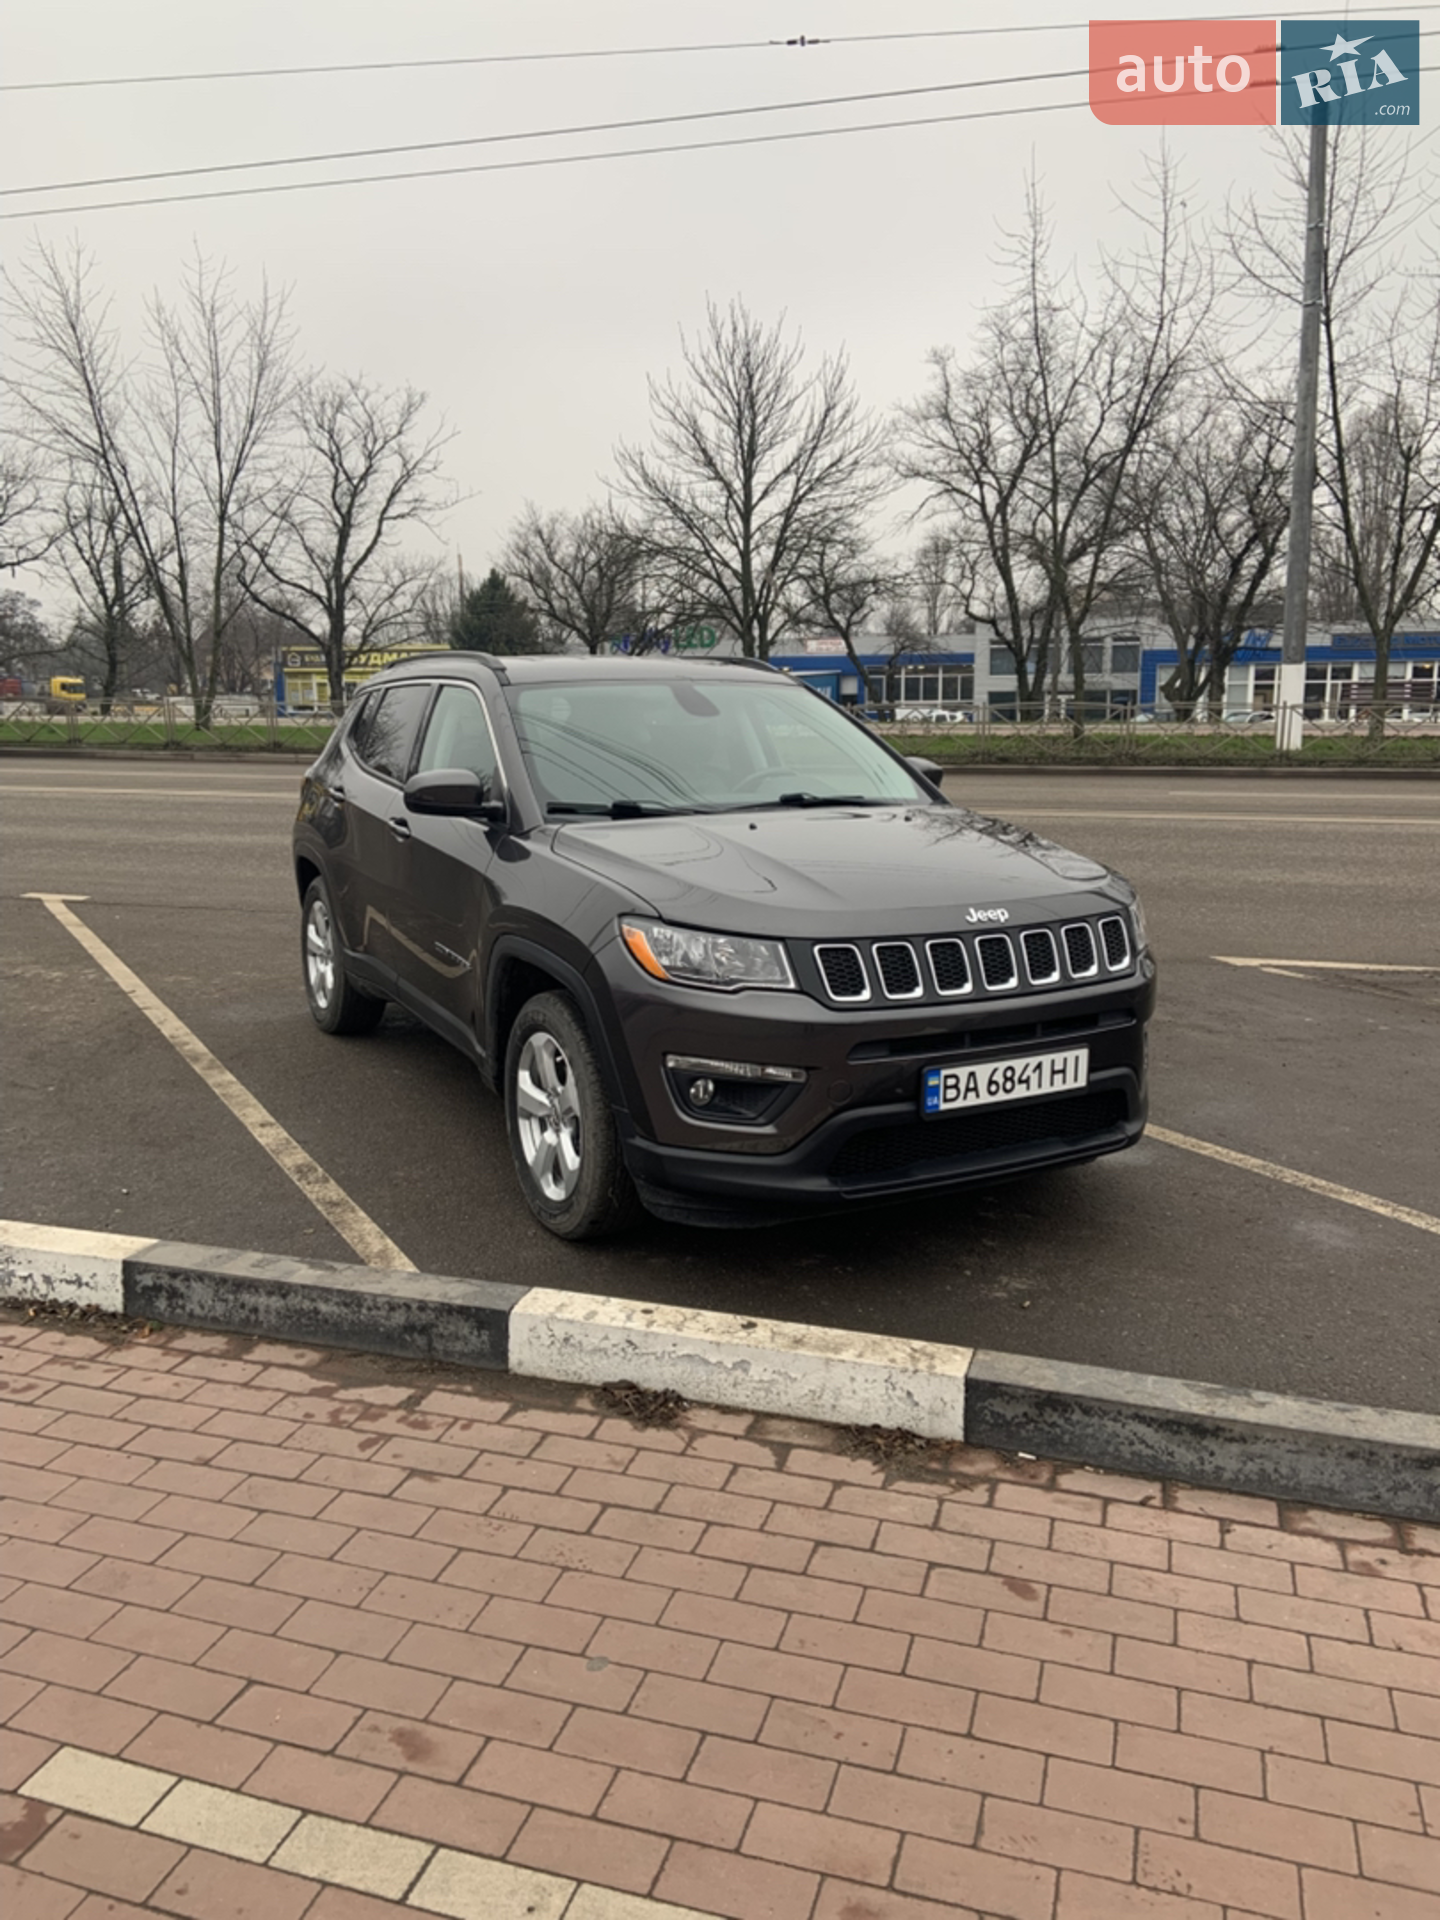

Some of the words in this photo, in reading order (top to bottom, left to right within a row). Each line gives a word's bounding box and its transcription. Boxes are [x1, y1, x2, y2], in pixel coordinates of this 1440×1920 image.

[965, 907, 1009, 923] Jeep
[943, 1071, 980, 1103] BA
[986, 1061, 1043, 1096] 6841
[1050, 1055, 1079, 1087] HI
